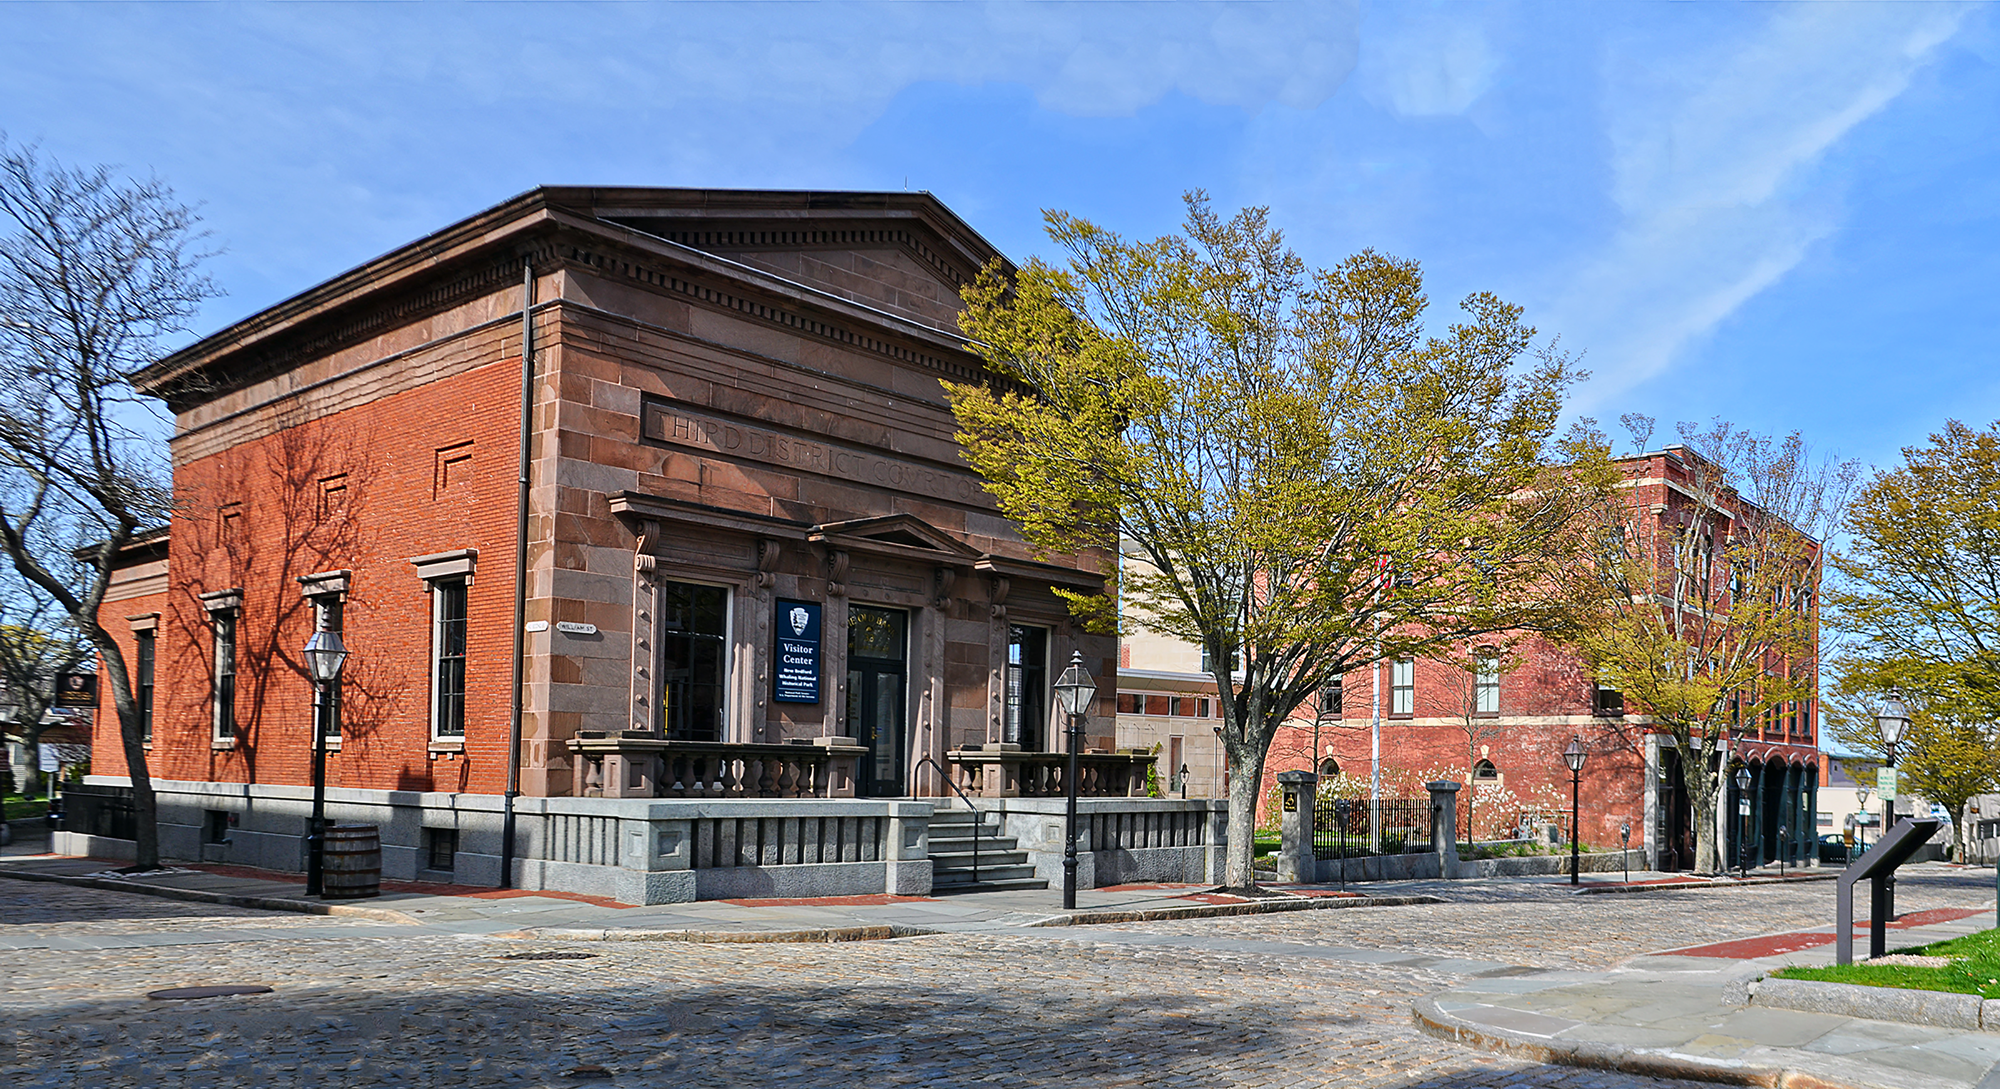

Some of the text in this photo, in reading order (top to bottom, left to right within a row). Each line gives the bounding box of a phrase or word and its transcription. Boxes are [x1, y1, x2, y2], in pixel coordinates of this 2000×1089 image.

[654, 409, 742, 449] THIRD
[749, 431, 865, 477] DISTRICT
[857, 613, 875, 622] OLD
[783, 642, 814, 654] Visitor
[783, 654, 814, 665] Center
[778, 673, 797, 681] Whaling
